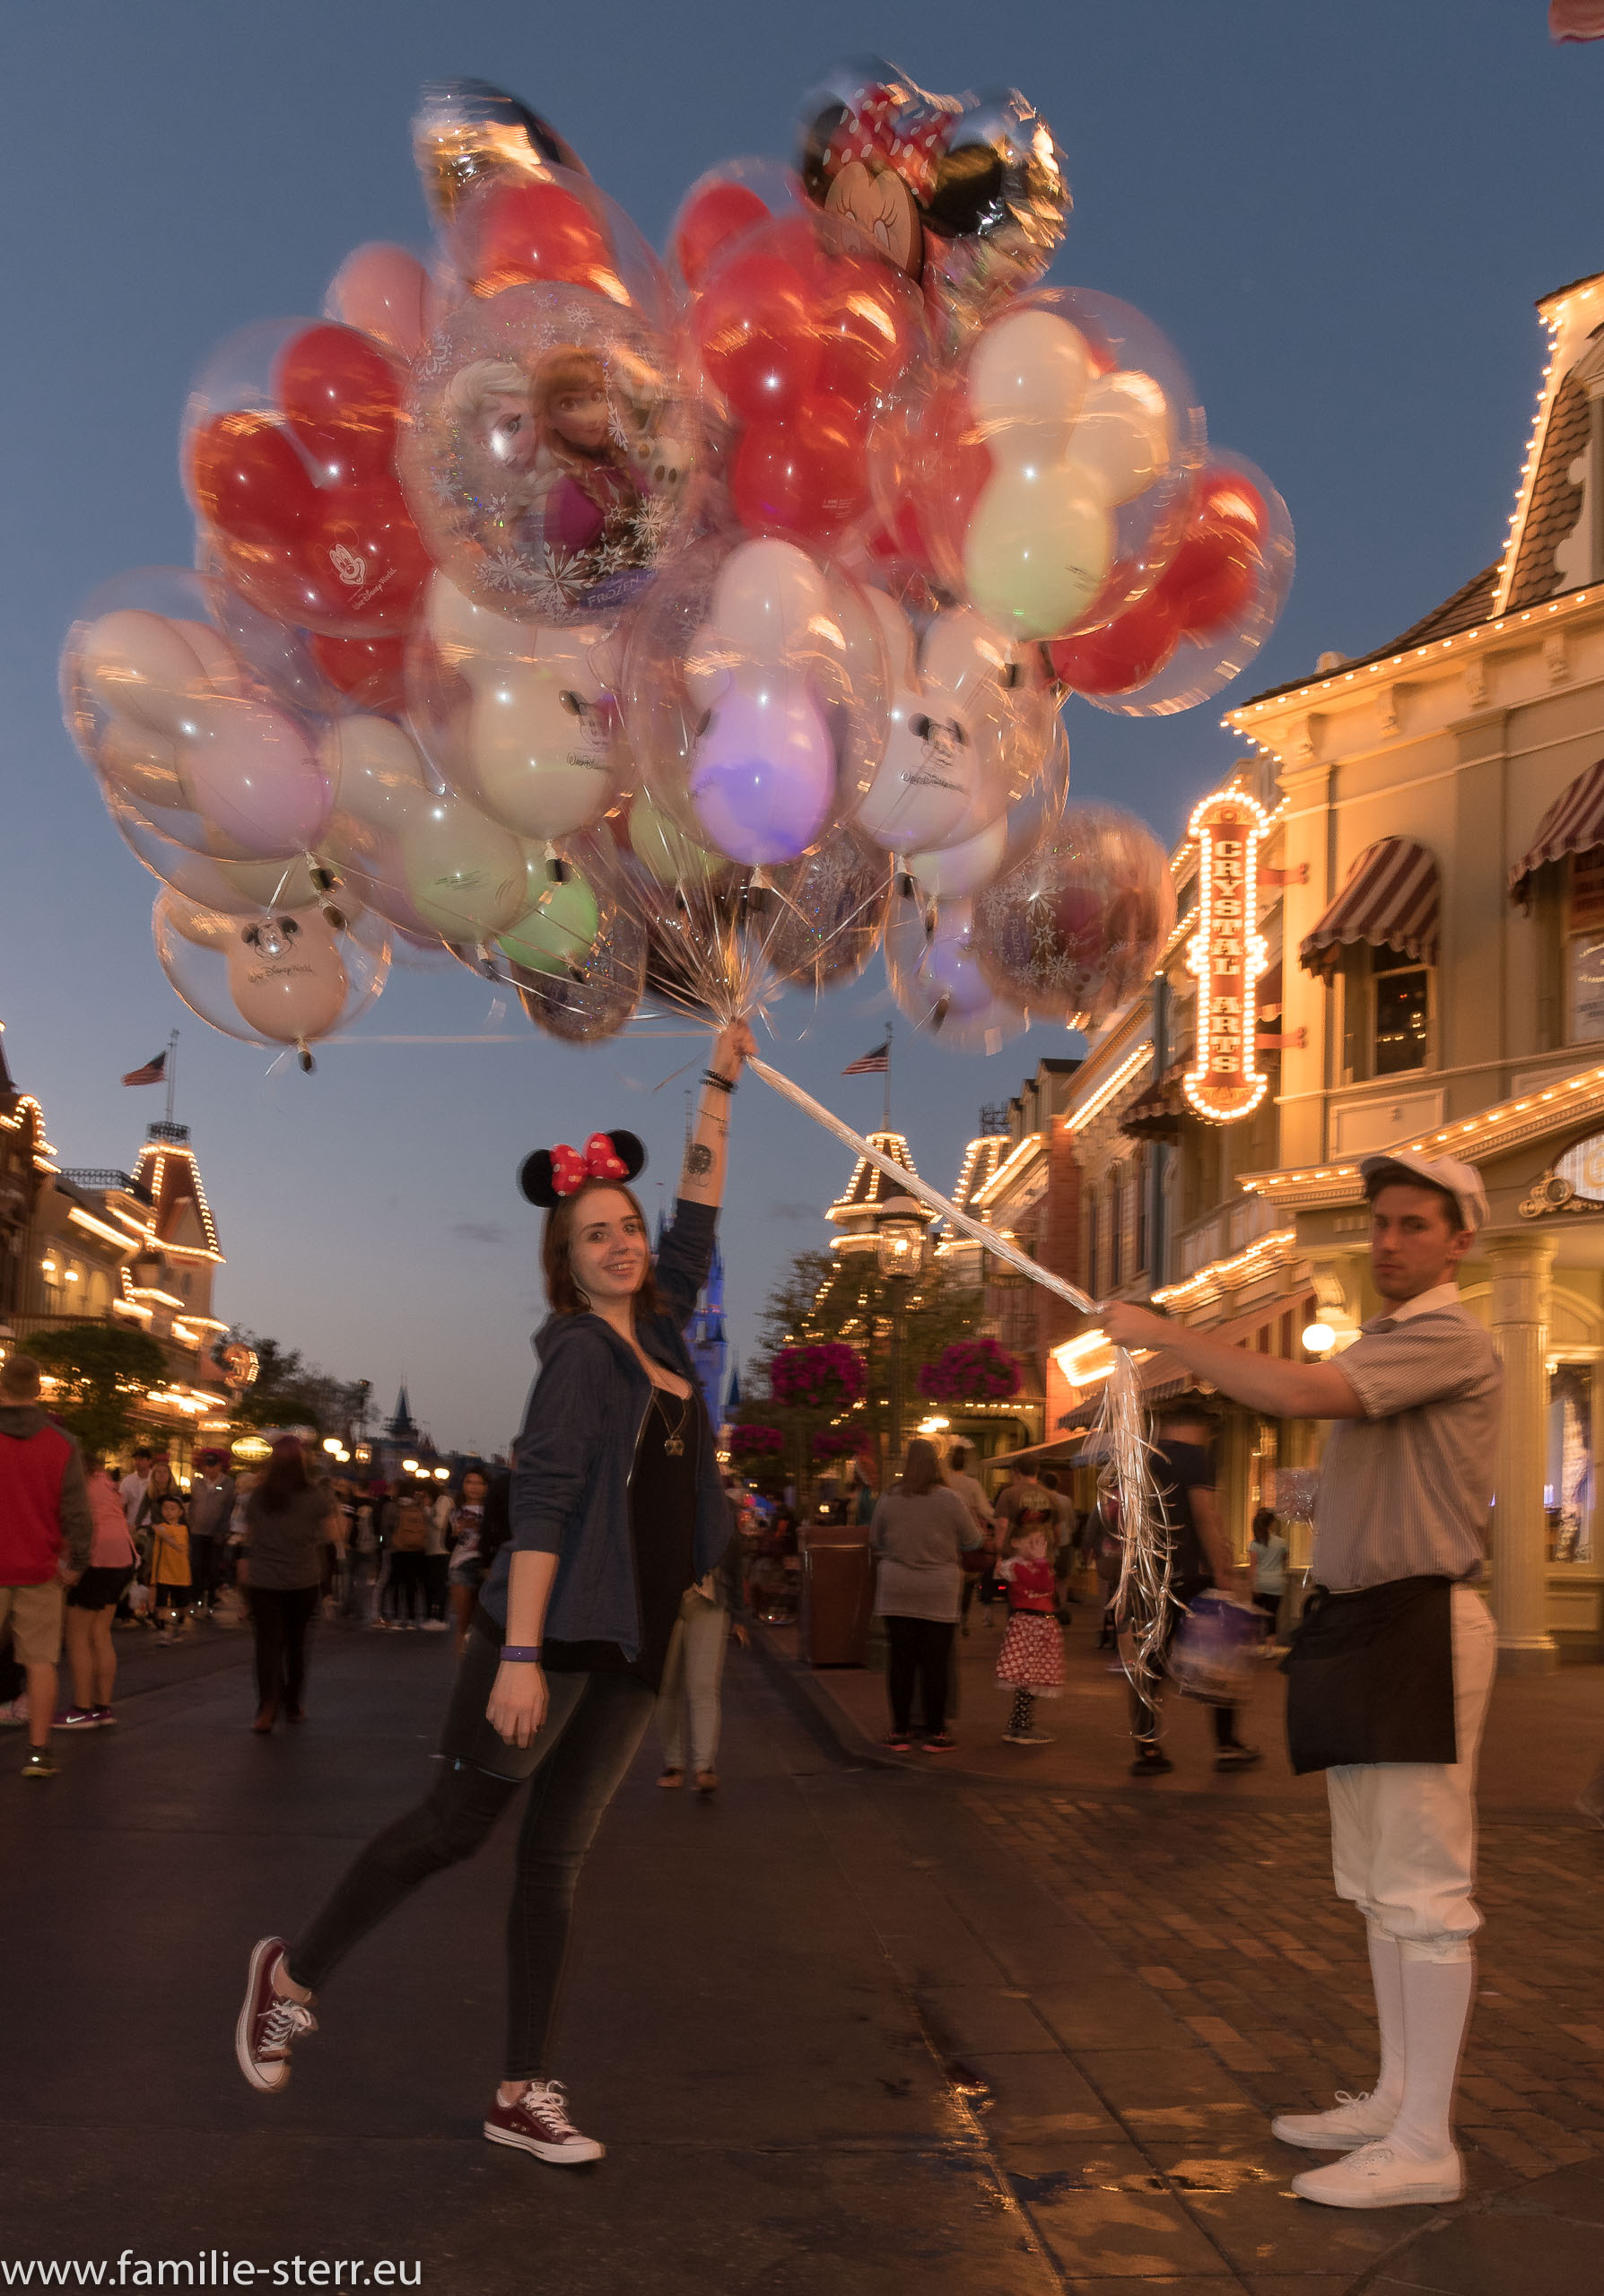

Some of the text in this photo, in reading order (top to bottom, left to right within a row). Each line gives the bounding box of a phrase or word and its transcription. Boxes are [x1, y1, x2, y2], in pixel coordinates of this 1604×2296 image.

[587, 574, 640, 608] FROZEN
[1210, 839, 1244, 1074] CRYSTAL ARTS
